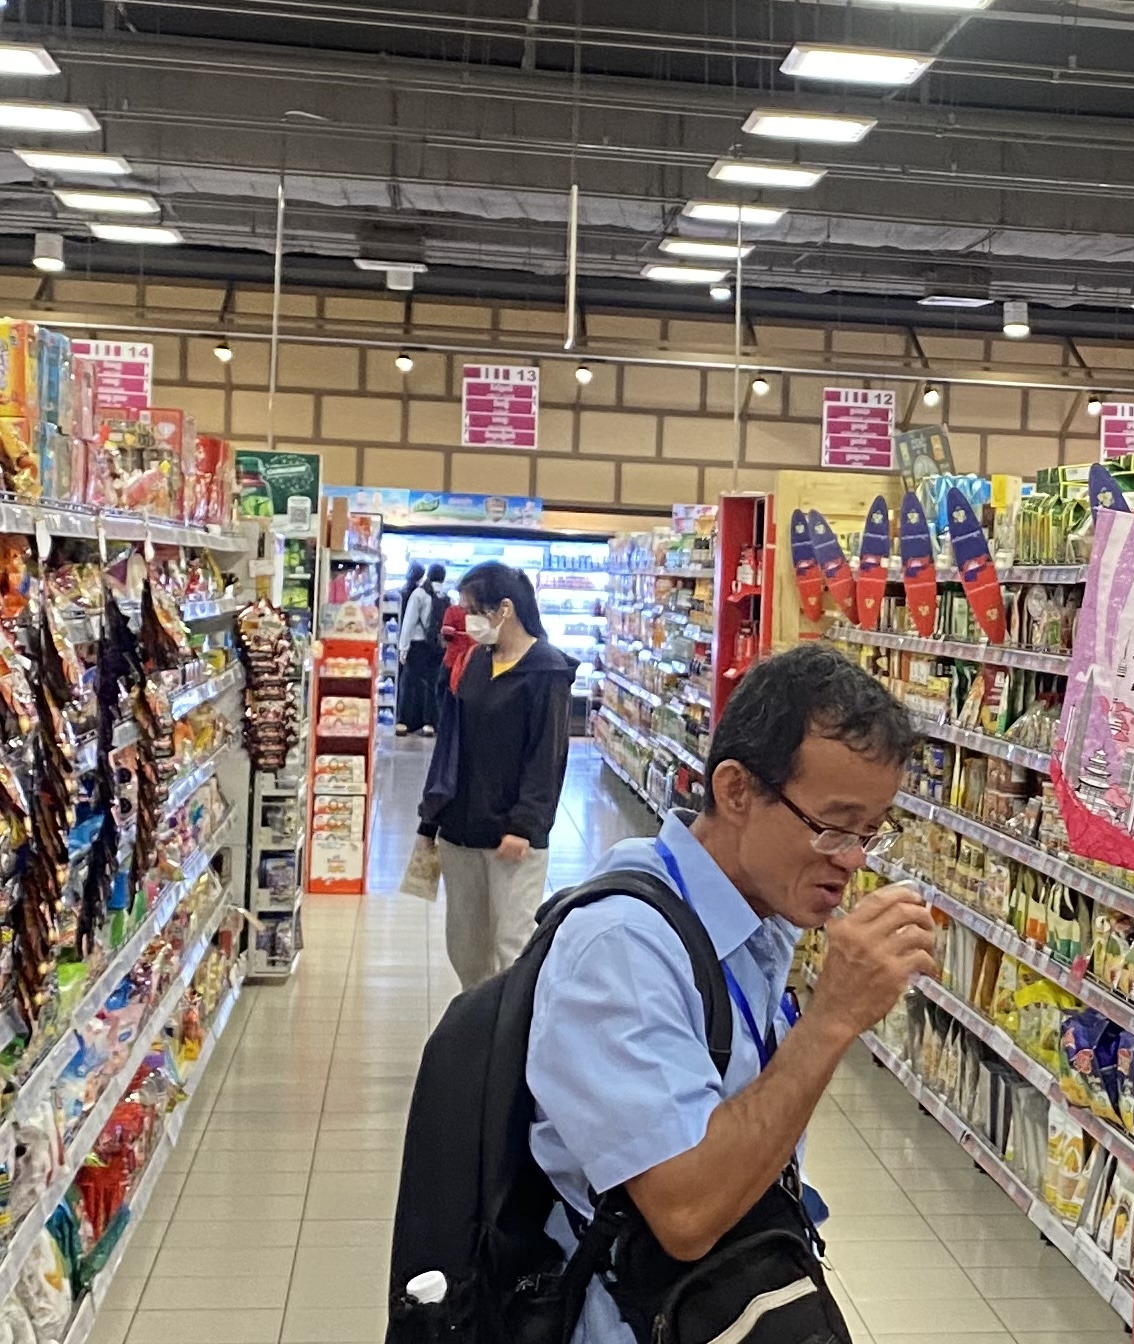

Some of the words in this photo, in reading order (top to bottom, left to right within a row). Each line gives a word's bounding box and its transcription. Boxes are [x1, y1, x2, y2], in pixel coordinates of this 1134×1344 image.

[128, 346, 149, 358] 14
[517, 369, 537, 382] 13
[874, 393, 893, 405] 12
